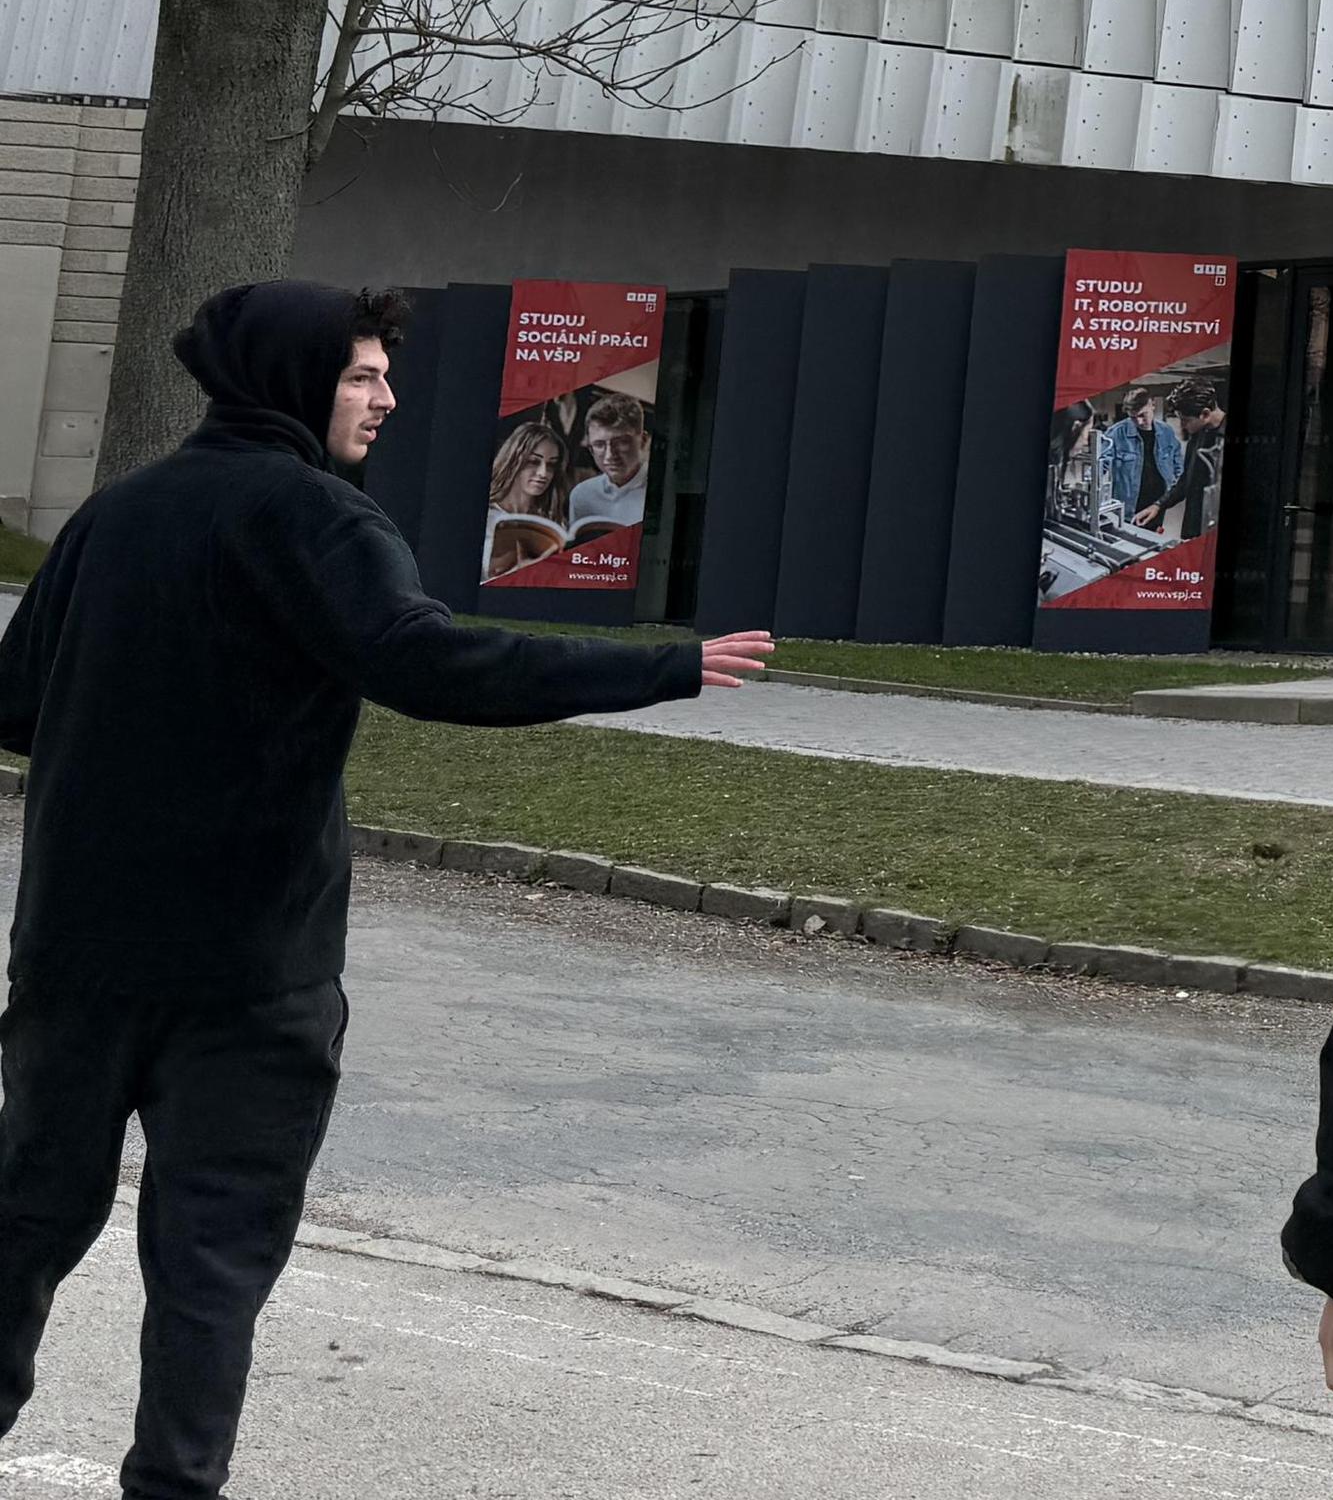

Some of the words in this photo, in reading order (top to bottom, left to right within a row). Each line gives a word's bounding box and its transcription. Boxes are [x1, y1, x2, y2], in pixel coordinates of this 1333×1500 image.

[1075, 280, 1143, 294] STUDUJ
[1074, 298, 1094, 313] IT,
[1098, 300, 1187, 314] ROBOTIKU
[519, 312, 586, 327] STUDUJ
[1072, 317, 1085, 330] A
[1088, 317, 1220, 335] STROJÍRENSTVÍ
[517, 329, 597, 346] SOCIÁLNÍ
[599, 332, 648, 348] PRÁCI
[1071, 336, 1096, 349] NA
[1099, 334, 1138, 350] VŠPJ
[515, 348, 540, 361] NA
[542, 347, 581, 363] VŠPJ
[599, 553, 630, 568] Mgr.
[1145, 567, 1172, 582] Bc.,
[1175, 567, 1204, 584] Ing.
